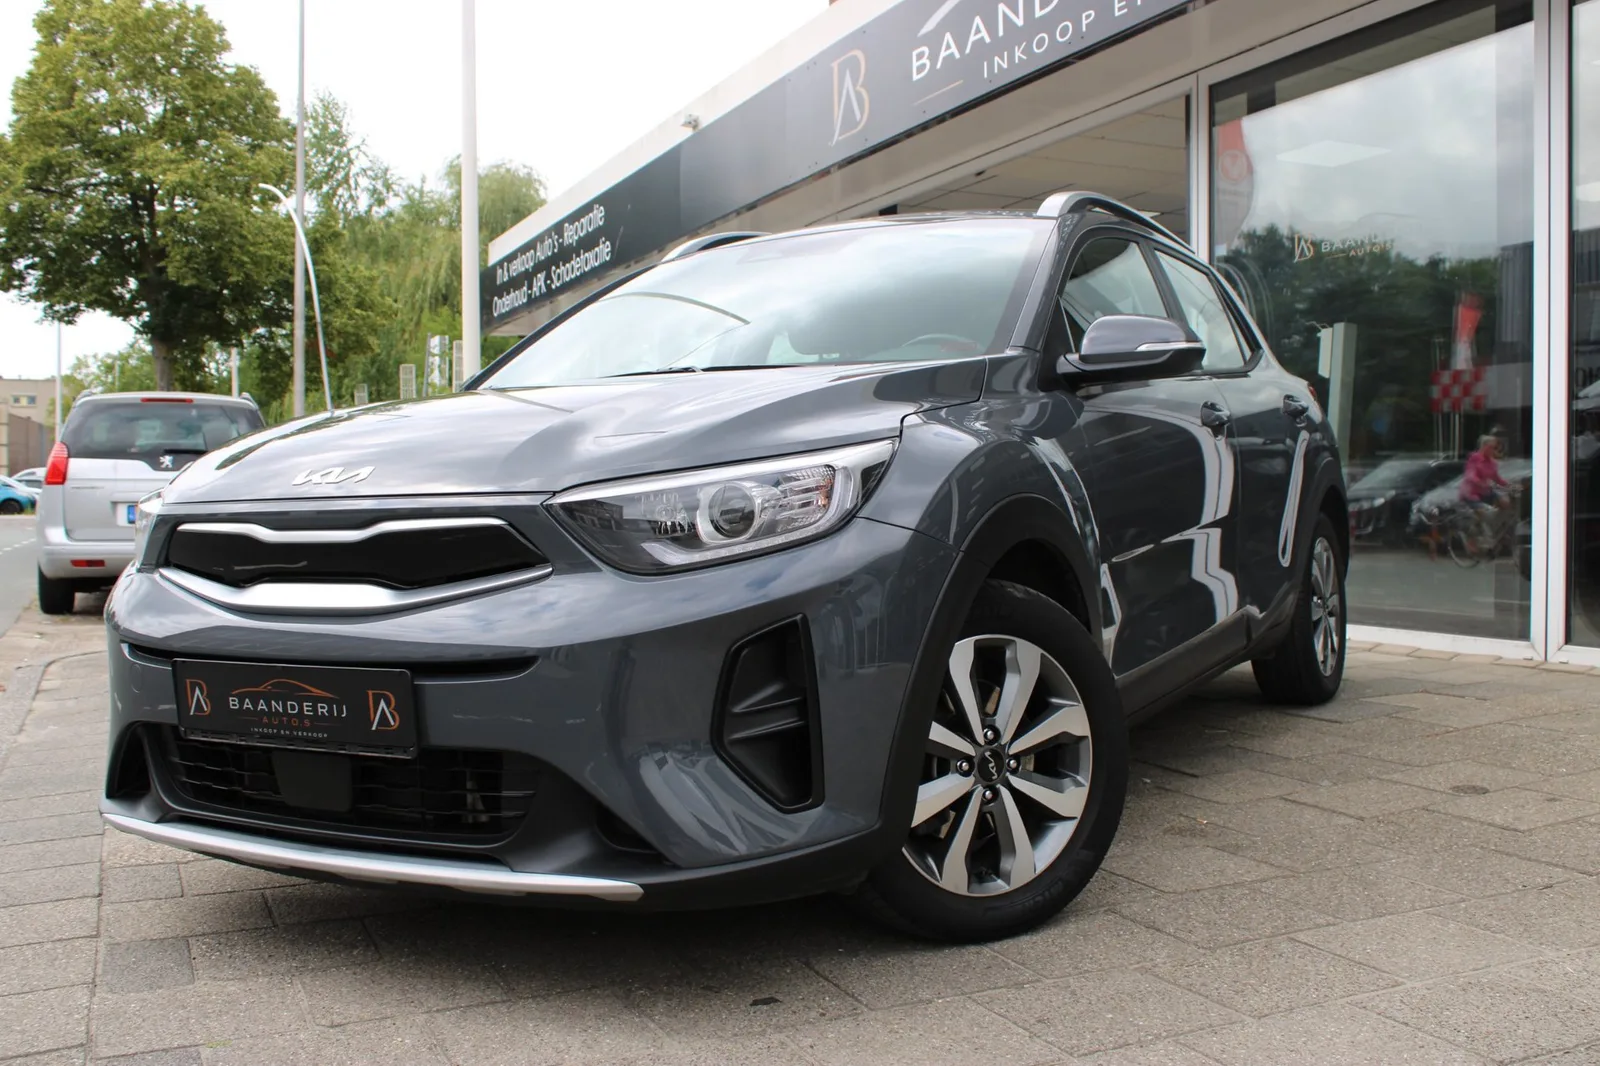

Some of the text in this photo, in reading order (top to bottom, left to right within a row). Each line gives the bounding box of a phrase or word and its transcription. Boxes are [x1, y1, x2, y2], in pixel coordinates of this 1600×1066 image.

[983, 0, 1141, 79] INKOOP E
[492, 280, 528, 317] Onderhoud
[532, 270, 547, 299] APK
[551, 236, 612, 290] Schadetaxatie
[496, 265, 503, 286] In
[503, 261, 509, 282] &
[509, 251, 535, 272] verkoop
[535, 231, 559, 263] Auto's
[563, 203, 605, 247] Reparatie
[228, 696, 347, 718] BAANDERIJ
